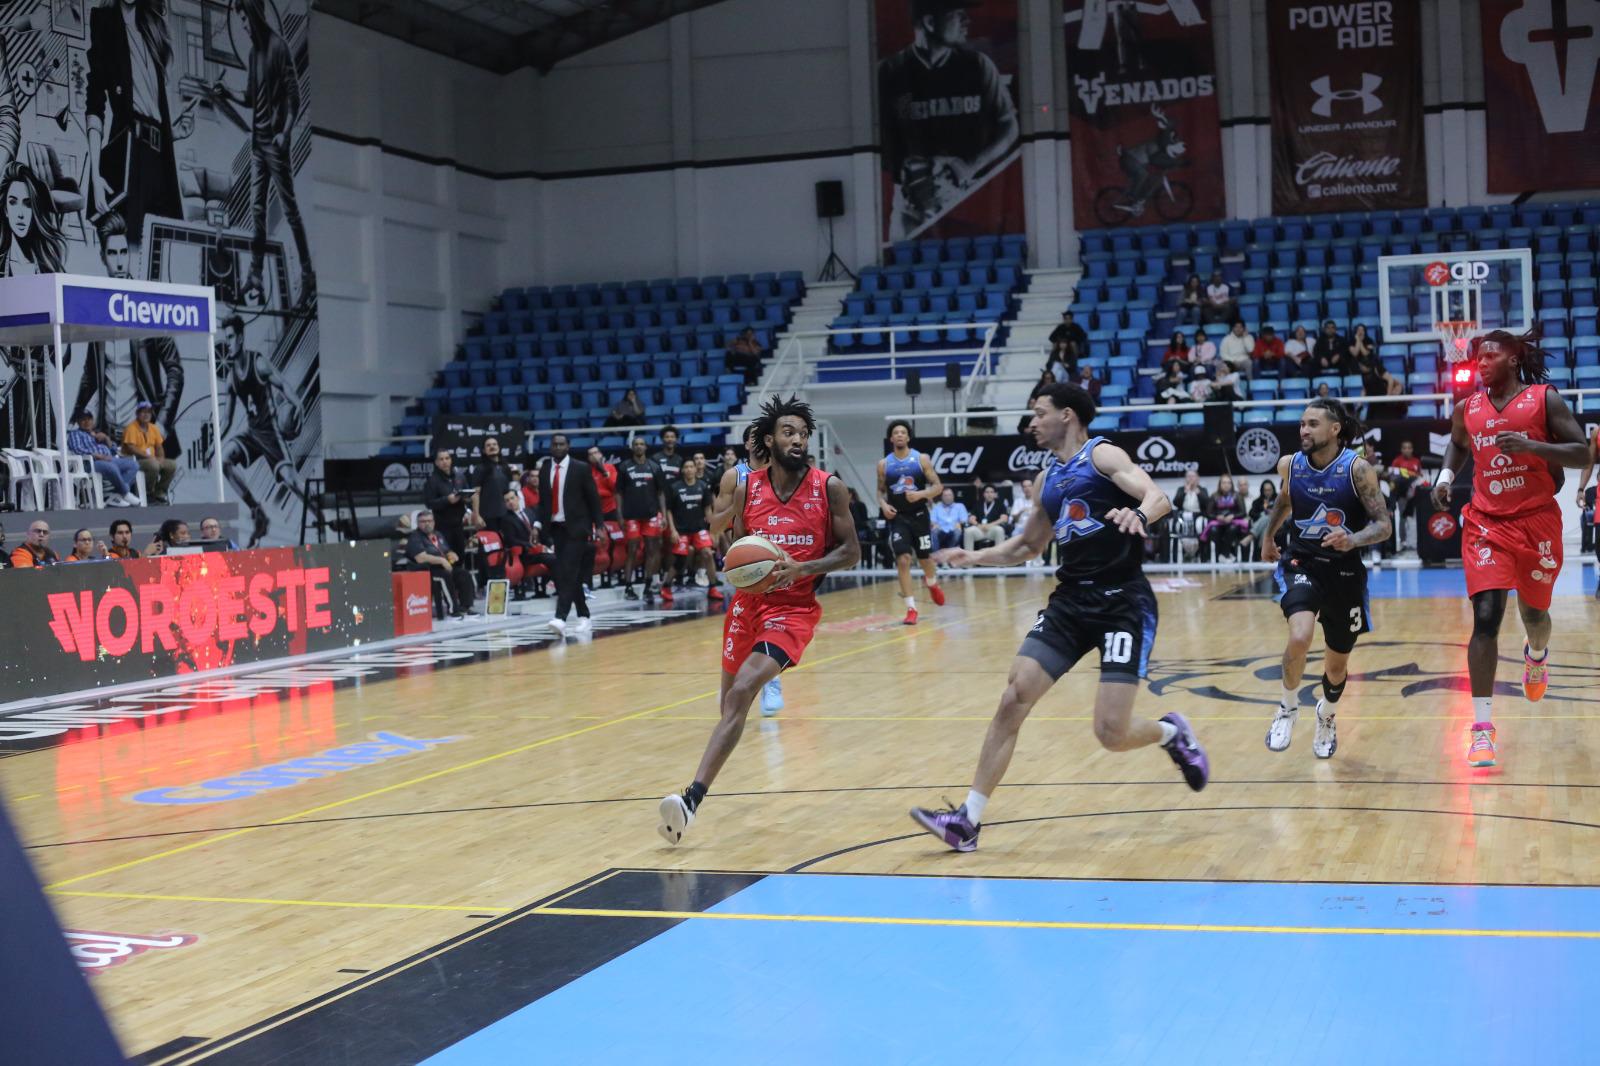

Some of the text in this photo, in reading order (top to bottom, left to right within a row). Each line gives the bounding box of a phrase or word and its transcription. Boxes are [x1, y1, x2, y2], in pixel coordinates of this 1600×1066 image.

[1289, 1, 1393, 31] POWER
[1337, 24, 1394, 50] ADE
[1073, 71, 1215, 115] VENADOS
[1298, 119, 1397, 134] UNDER ARMOUR
[1295, 151, 1401, 186] Caliente
[1322, 182, 1399, 196] caliente.mx
[1450, 262, 1489, 280] CID
[108, 293, 199, 327] Chevron
[930, 446, 984, 475] lcel
[1155, 460, 1199, 472] Azteca
[1502, 464, 1528, 475] Azteca
[1502, 476, 1525, 489] UAD
[918, 535, 932, 550] 15
[1476, 558, 1496, 568] MEGA
[47, 566, 332, 661] NOROESTE
[1350, 606, 1363, 633] 3
[1102, 631, 1133, 664] 10
[132, 731, 464, 804] Comex
